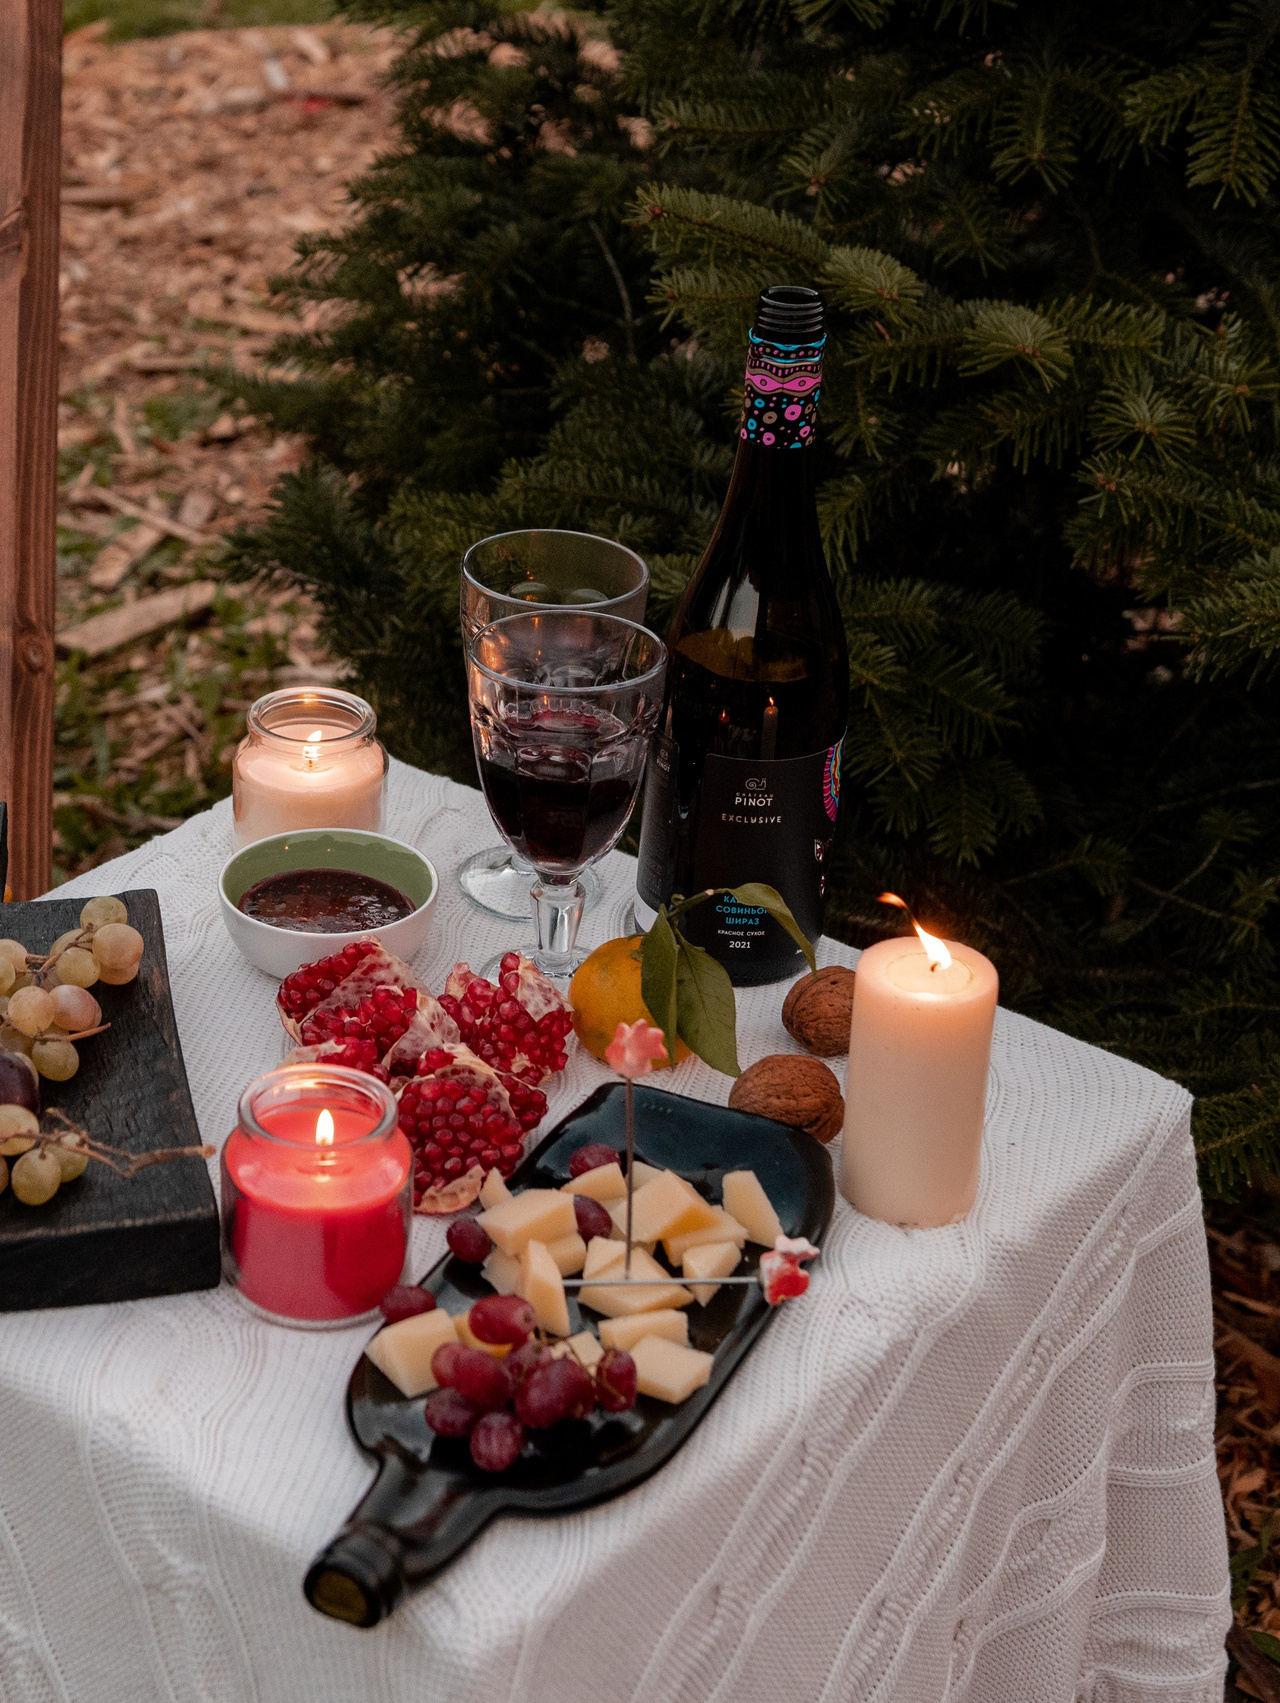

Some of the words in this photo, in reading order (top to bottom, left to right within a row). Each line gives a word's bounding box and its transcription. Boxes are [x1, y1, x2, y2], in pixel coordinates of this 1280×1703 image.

[734, 796, 773, 807] PINOT
[721, 813, 782, 823] EXCLUSIVE
[715, 905, 768, 915] СОВИНЬО
[725, 916, 760, 925] ШИРАЗ
[728, 940, 751, 949] 2021
